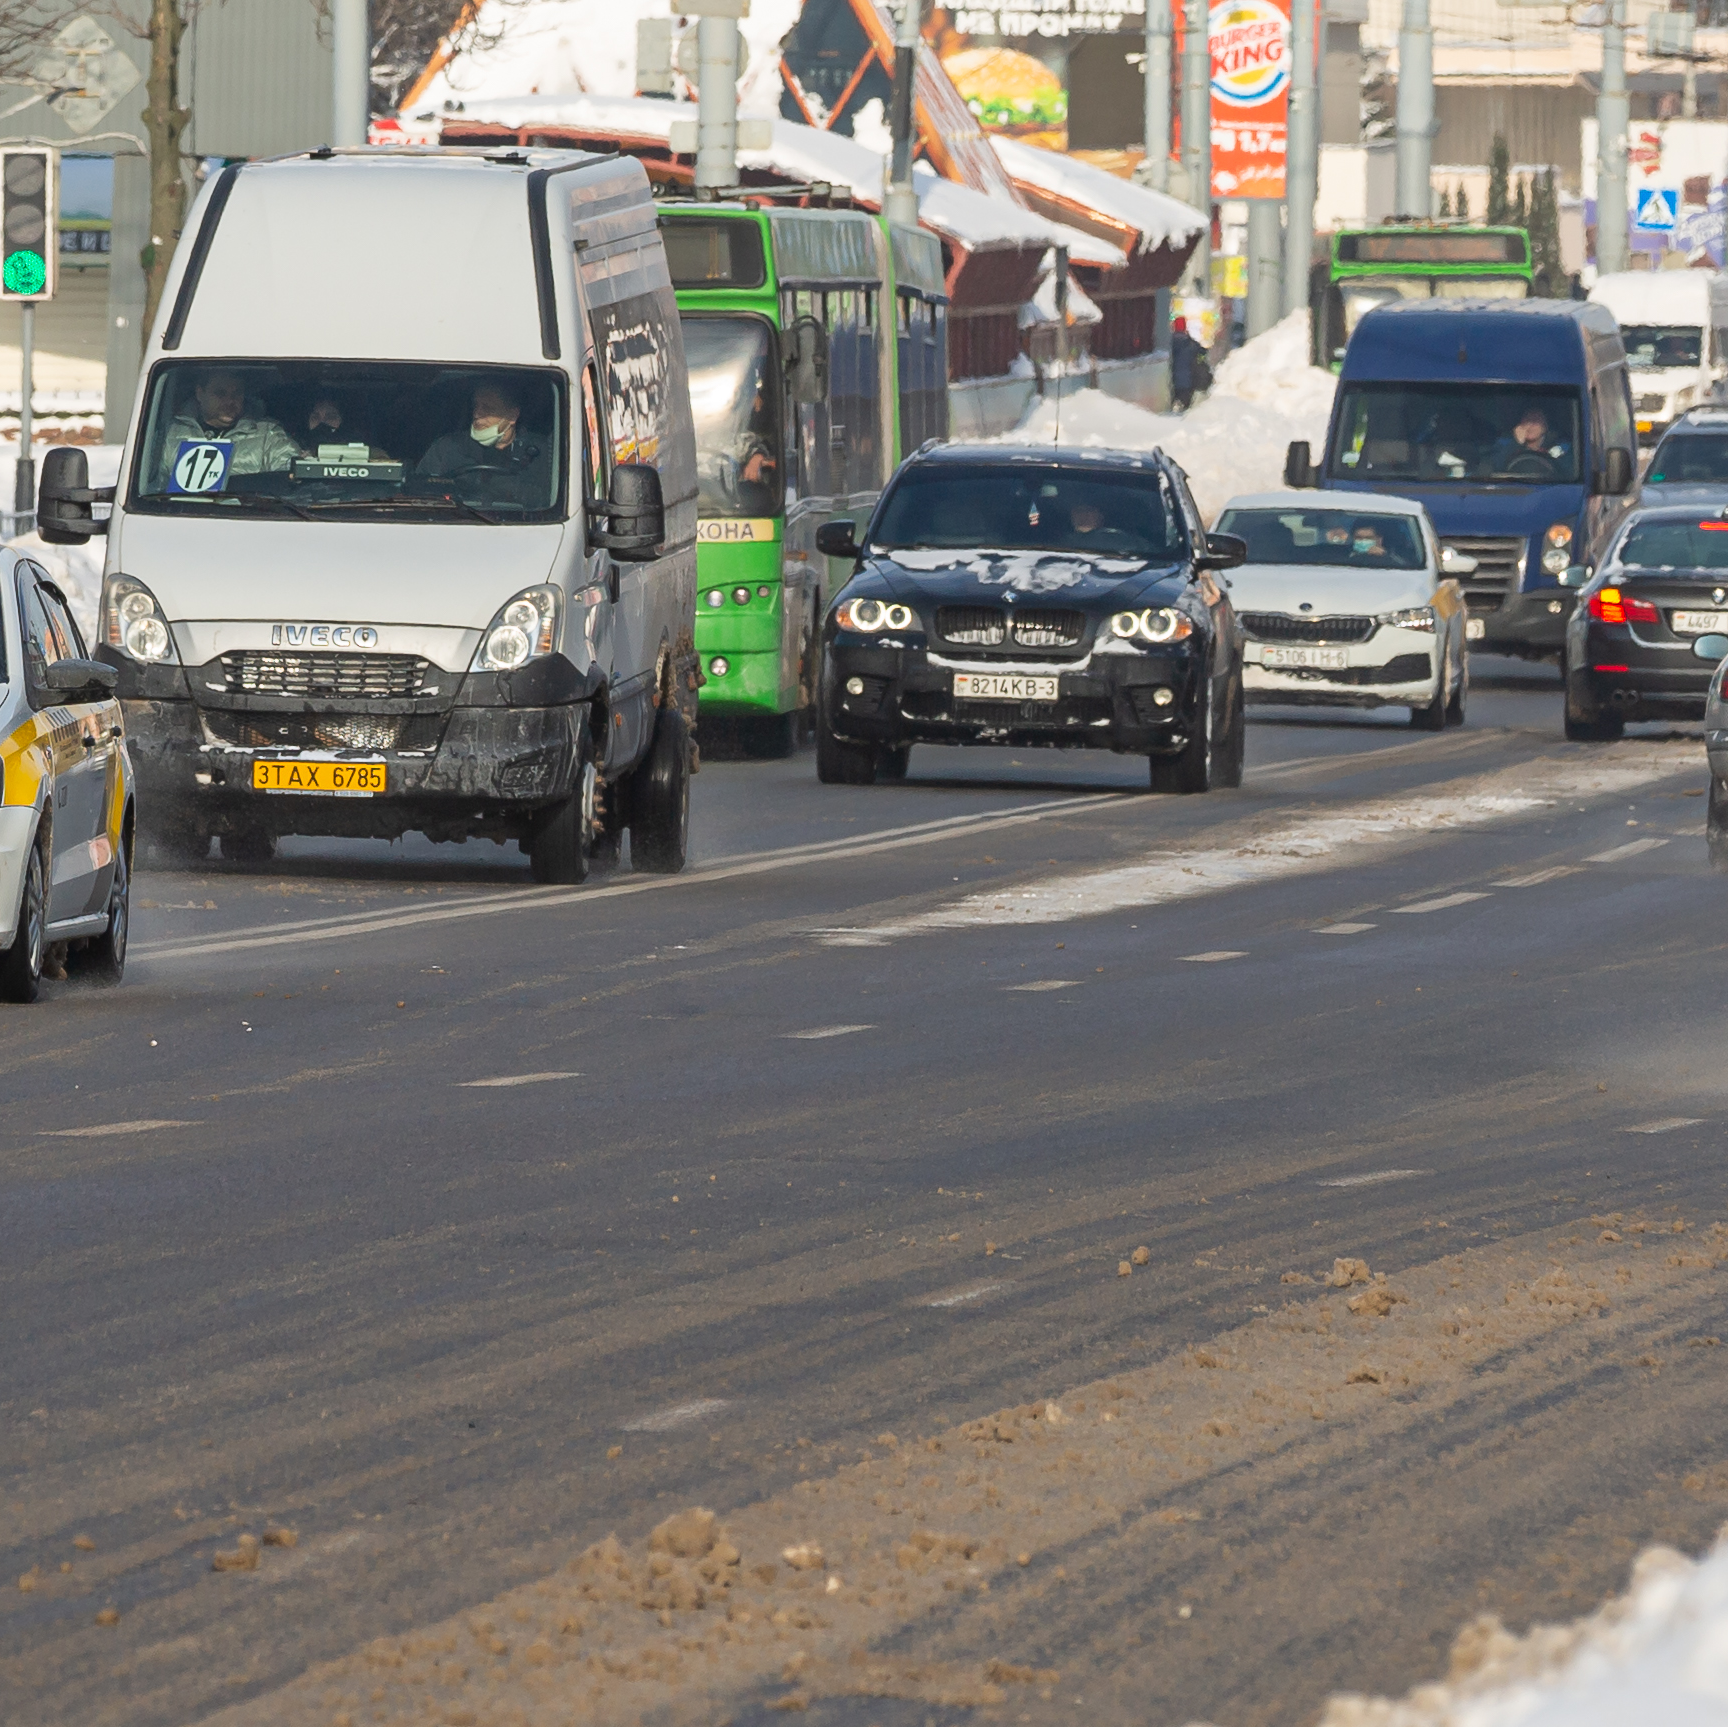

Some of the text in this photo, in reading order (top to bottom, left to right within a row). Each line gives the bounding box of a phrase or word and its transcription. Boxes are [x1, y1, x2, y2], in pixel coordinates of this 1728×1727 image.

[1212, 39, 1284, 73] KING
[185, 448, 219, 489] 17
[324, 467, 369, 477] IVECO
[271, 624, 378, 648] IVECO
[258, 765, 381, 788] 3TAX 6785
